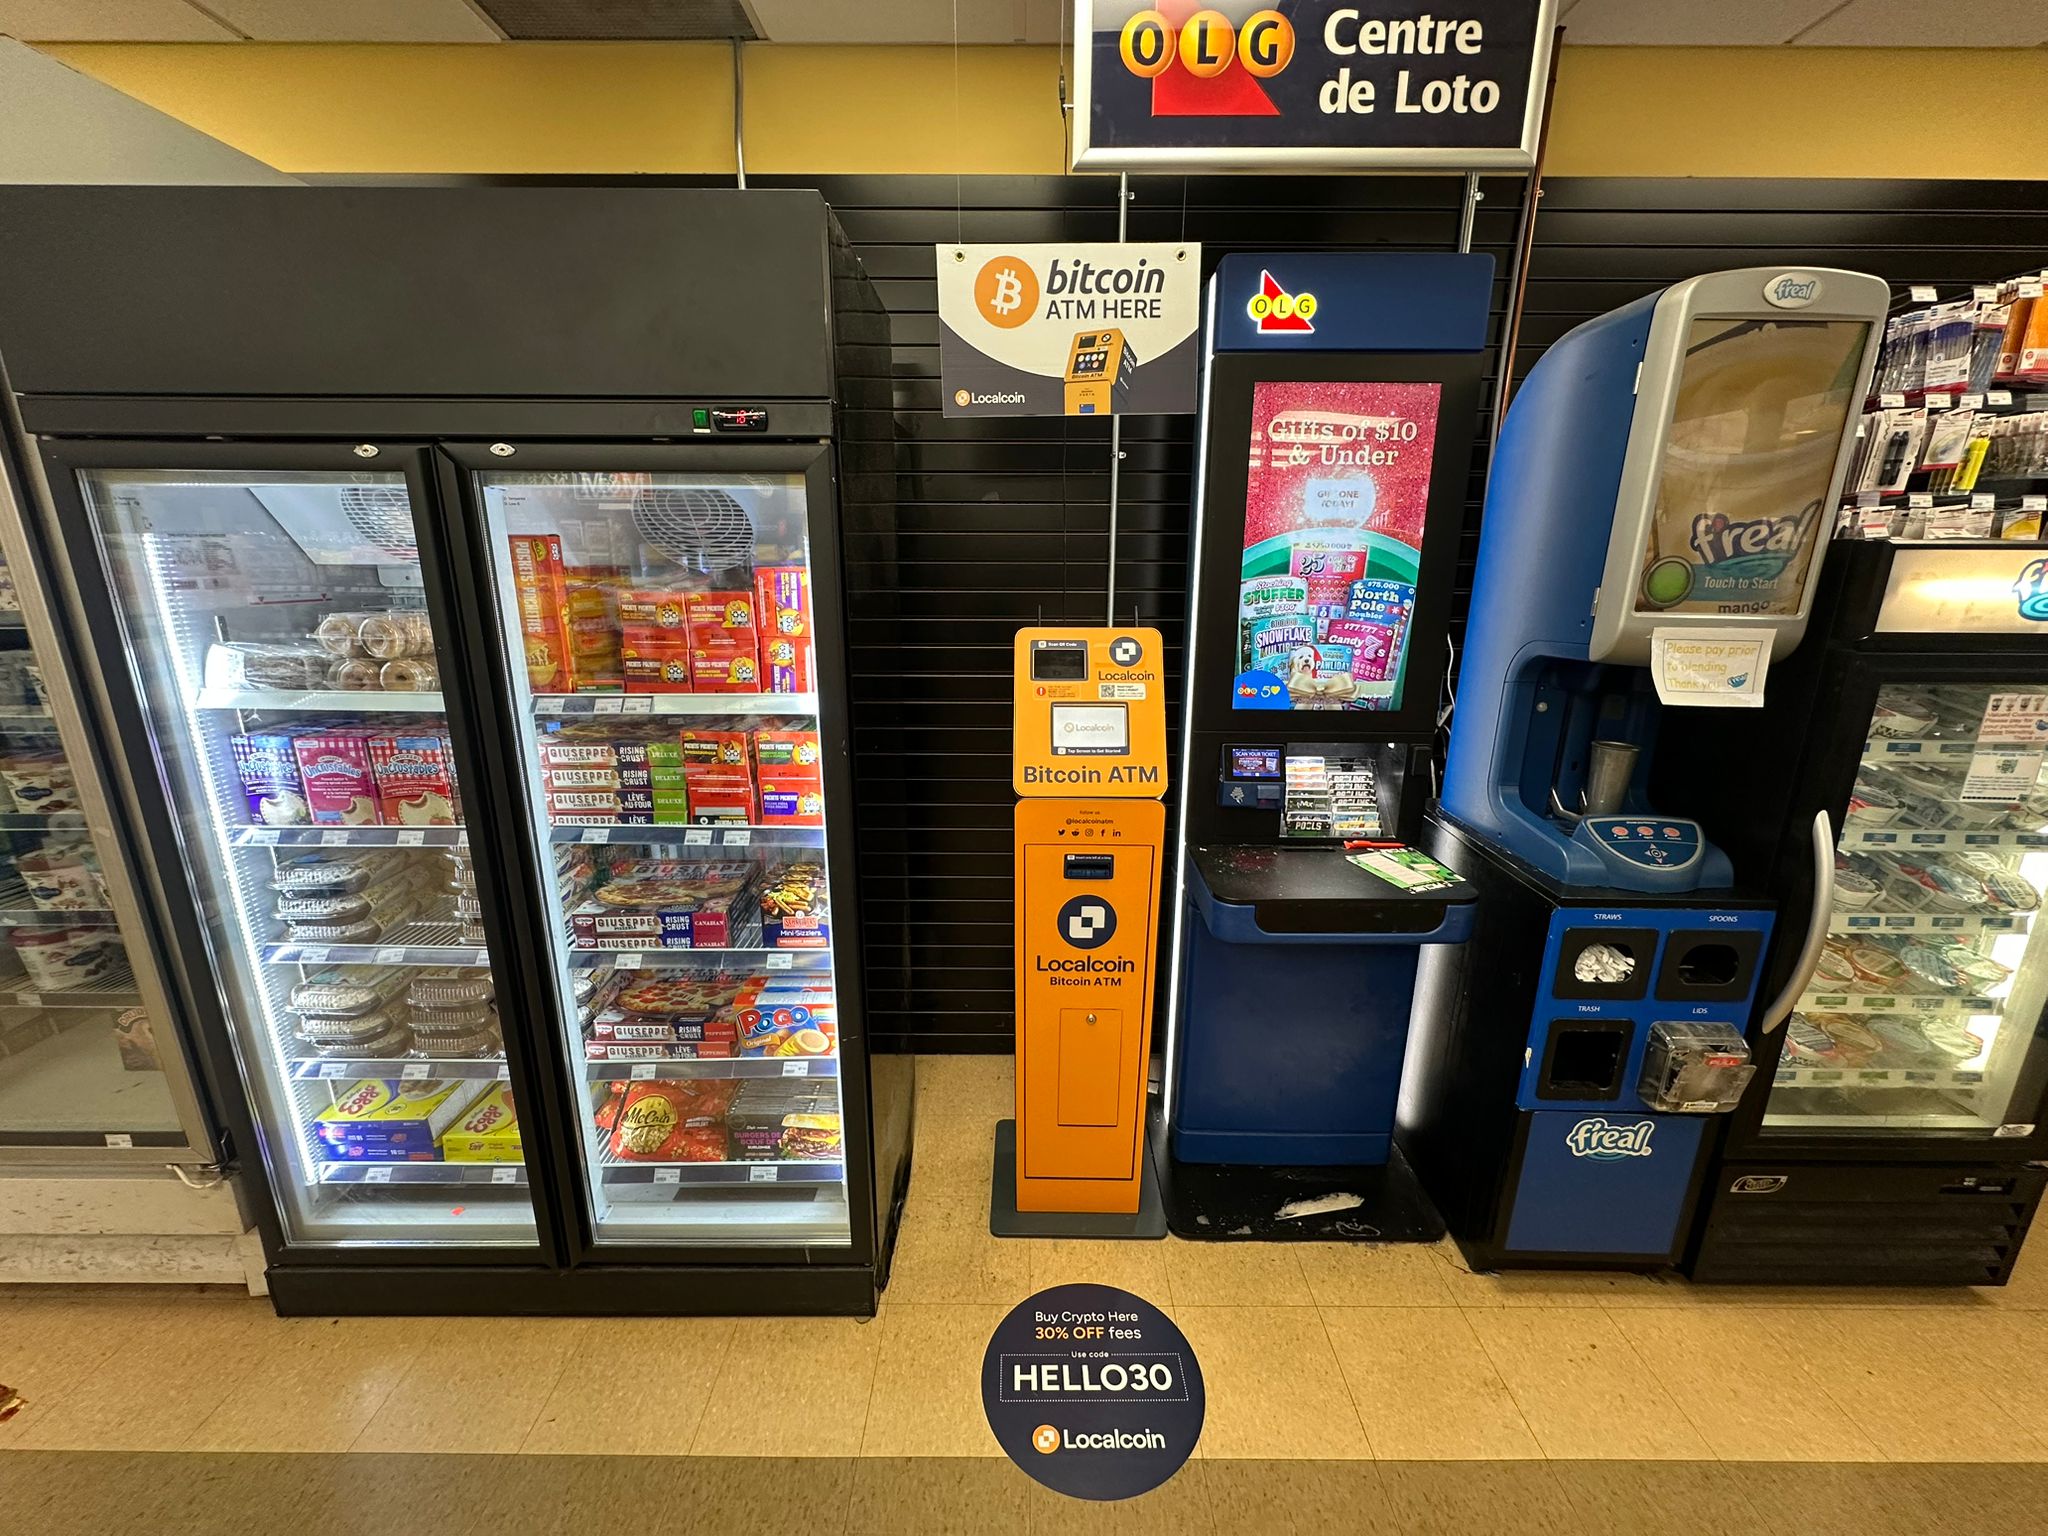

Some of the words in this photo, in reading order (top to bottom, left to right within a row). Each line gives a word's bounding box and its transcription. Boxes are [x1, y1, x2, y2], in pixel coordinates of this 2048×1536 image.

[1129, 19, 1281, 66] OLG
[1324, 10, 1482, 56] Centre
[1319, 71, 1375, 114] de
[1395, 73, 1500, 113] Loto
[1046, 258, 1165, 294] bitcoin
[1046, 301, 1094, 319] ATM
[1103, 299, 1161, 318] HERE
[1254, 297, 1311, 315] OLG
[972, 392, 1025, 404] Localcoin
[1268, 419, 1334, 441] Gifts
[1342, 420, 1370, 441] of
[1375, 422, 1417, 442] $10
[1289, 445, 1309, 464] &
[1319, 445, 1398, 465] Under
[515, 541, 535, 582] POCKETS
[1704, 576, 1735, 588] Touch
[1738, 578, 1749, 589] to
[1752, 577, 1778, 589] Start
[1244, 588, 1305, 606] STUFFER
[1352, 589, 1399, 603] North
[1350, 600, 1385, 611] Pole
[1718, 601, 1770, 614] mango
[1349, 611, 1383, 620] Doubler
[1256, 627, 1312, 647] SNOWFLAKE
[1329, 635, 1364, 647] Candy
[1667, 643, 1704, 654] Please
[1705, 646, 1724, 657] pay
[1728, 645, 1757, 657] prior
[1667, 662, 1678, 671] to
[1680, 661, 1727, 675] blending
[1098, 671, 1155, 681] Localcoin
[1668, 679, 1697, 689] Thank
[1702, 681, 1720, 692] you
[1076, 724, 1114, 732] Localcoin
[550, 747, 607, 758] GIUSEPPE
[304, 763, 361, 777] Uncrustables
[376, 762, 439, 775] Uncrustables
[623, 770, 648, 778] RISING
[1024, 766, 1101, 783] Bitcoin
[1108, 766, 1158, 783] ATM
[554, 770, 610, 781] GIUSEPPE
[556, 795, 612, 804] GIUSEPPE
[598, 919, 652, 928] GIUSEPPE
[600, 940, 655, 948] GIUSEPPE
[1037, 955, 1135, 972] Localcoin
[1050, 977, 1091, 986] Bitcoin
[1094, 977, 1121, 986] ATM
[616, 1027, 667, 1035] GIUSEPPE
[746, 1036, 772, 1046] Original
[609, 1047, 660, 1056] GIUSEPPE
[338, 1085, 380, 1115] Eggo
[464, 1104, 502, 1133] Eggo
[627, 1107, 670, 1124] McCain
[1036, 1312, 1057, 1324] Buy
[1062, 1312, 1105, 1324] Crypto
[1108, 1312, 1138, 1322] Here
[1036, 1327, 1069, 1339] 30%
[1072, 1327, 1105, 1339] OFF
[1108, 1326, 1142, 1339] fees
[1013, 1363, 1172, 1391] HELLO30
[1064, 1429, 1166, 1449] Localcoin
